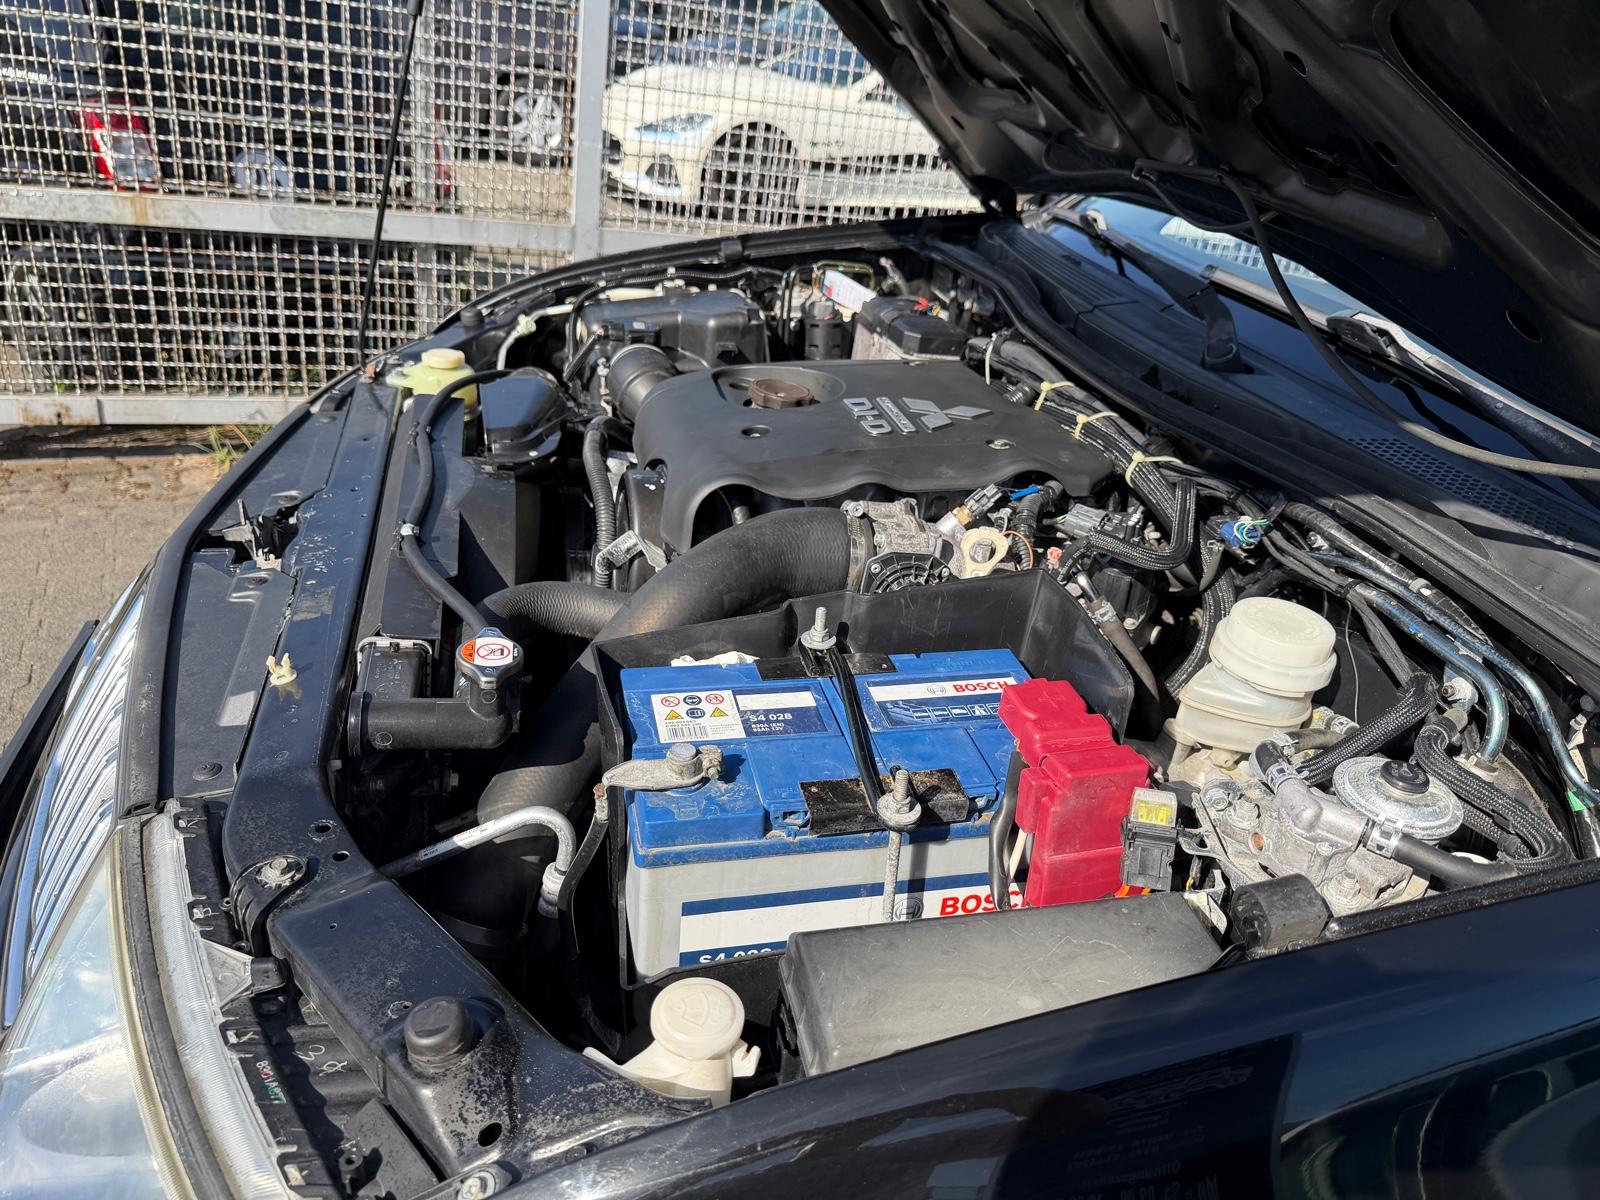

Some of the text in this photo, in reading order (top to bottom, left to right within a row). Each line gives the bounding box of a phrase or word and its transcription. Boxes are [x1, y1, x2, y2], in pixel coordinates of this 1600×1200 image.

[952, 681, 1009, 693] BOSCH
[749, 712, 793, 722] S4 028
